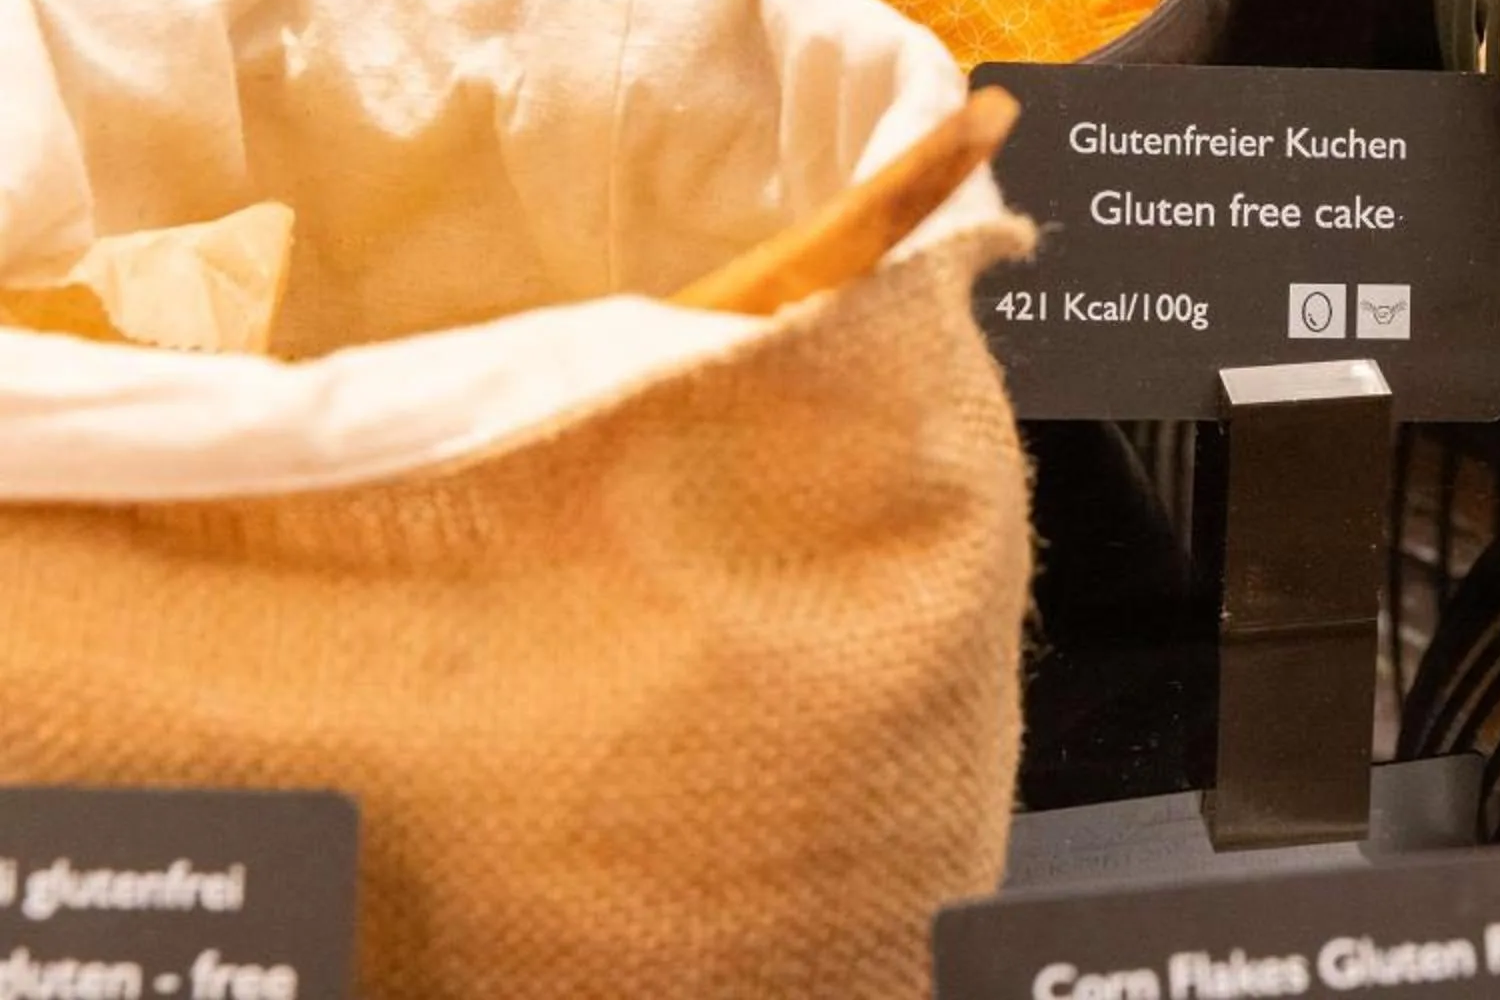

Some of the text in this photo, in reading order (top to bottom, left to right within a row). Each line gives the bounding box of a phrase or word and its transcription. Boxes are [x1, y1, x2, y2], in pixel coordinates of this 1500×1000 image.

[1068, 122, 1407, 161] Glutenfreier Kuchen
[1090, 189, 1396, 230] Gluten free cake
[995, 290, 1210, 330] 421 Kcal/100g
[22, 856, 247, 921] glutenfrei
[190, 947, 298, 1000] free
[1167, 947, 1309, 1000] Flakes
[1317, 932, 1478, 993] Gluten
